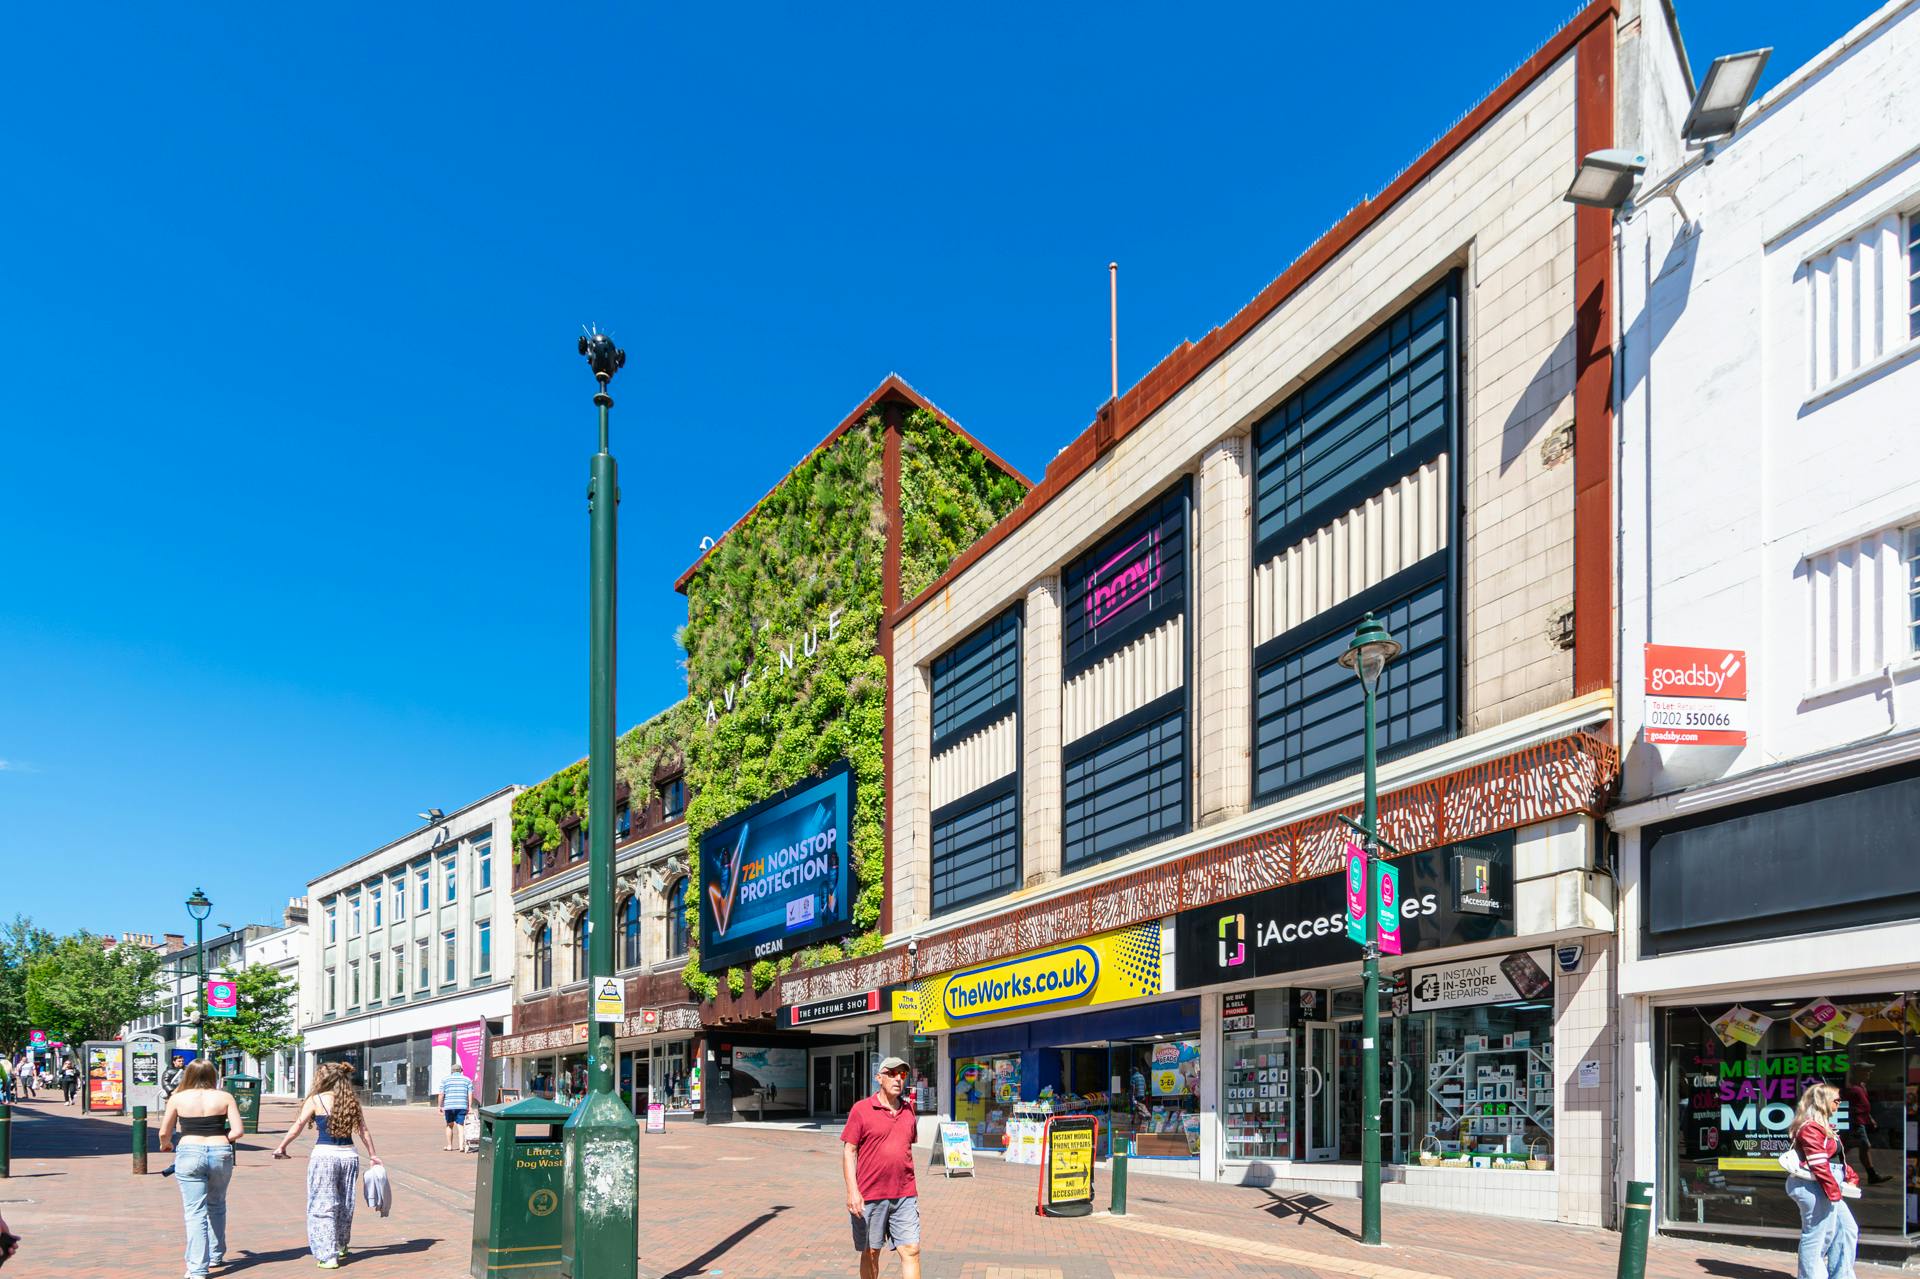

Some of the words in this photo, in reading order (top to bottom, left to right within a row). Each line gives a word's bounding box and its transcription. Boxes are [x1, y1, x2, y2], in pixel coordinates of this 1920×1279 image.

[1651, 663, 1726, 694] goadsby
[1651, 711, 1682, 725] 01202
[1686, 712, 1731, 726] 550066
[1650, 731, 1699, 743] goadsby.com
[741, 857, 765, 883] 72H
[767, 827, 837, 872] NONSTOP
[740, 854, 829, 905] PROTECTION
[1256, 893, 1438, 948] iAcceses
[755, 938, 783, 958] OCEAN
[1443, 965, 1488, 980] INSTANT
[949, 958, 1088, 1010] TheWorks.co.uk
[1443, 975, 1497, 990] IN-STORE
[1443, 987, 1489, 1001] REPAIRS
[799, 1010, 812, 1019] THE
[814, 1003, 844, 1016] PERFUME
[847, 999, 867, 1010] SHOP
[1225, 1007, 1248, 1015] PHONES
[1720, 1054, 1850, 1078] MEMBERS
[1720, 1078, 1796, 1101] SAVE
[1720, 1101, 1850, 1131] MOE
[1053, 1133, 1073, 1141] INSTANT
[526, 1147, 552, 1156] Litter
[1071, 1141, 1091, 1149] REPAIRS
[1733, 1139, 1758, 1151] VIP
[516, 1159, 537, 1170] Dog
[538, 1159, 564, 1167] Wast
[1052, 1188, 1088, 1198] ACCESSORIES
